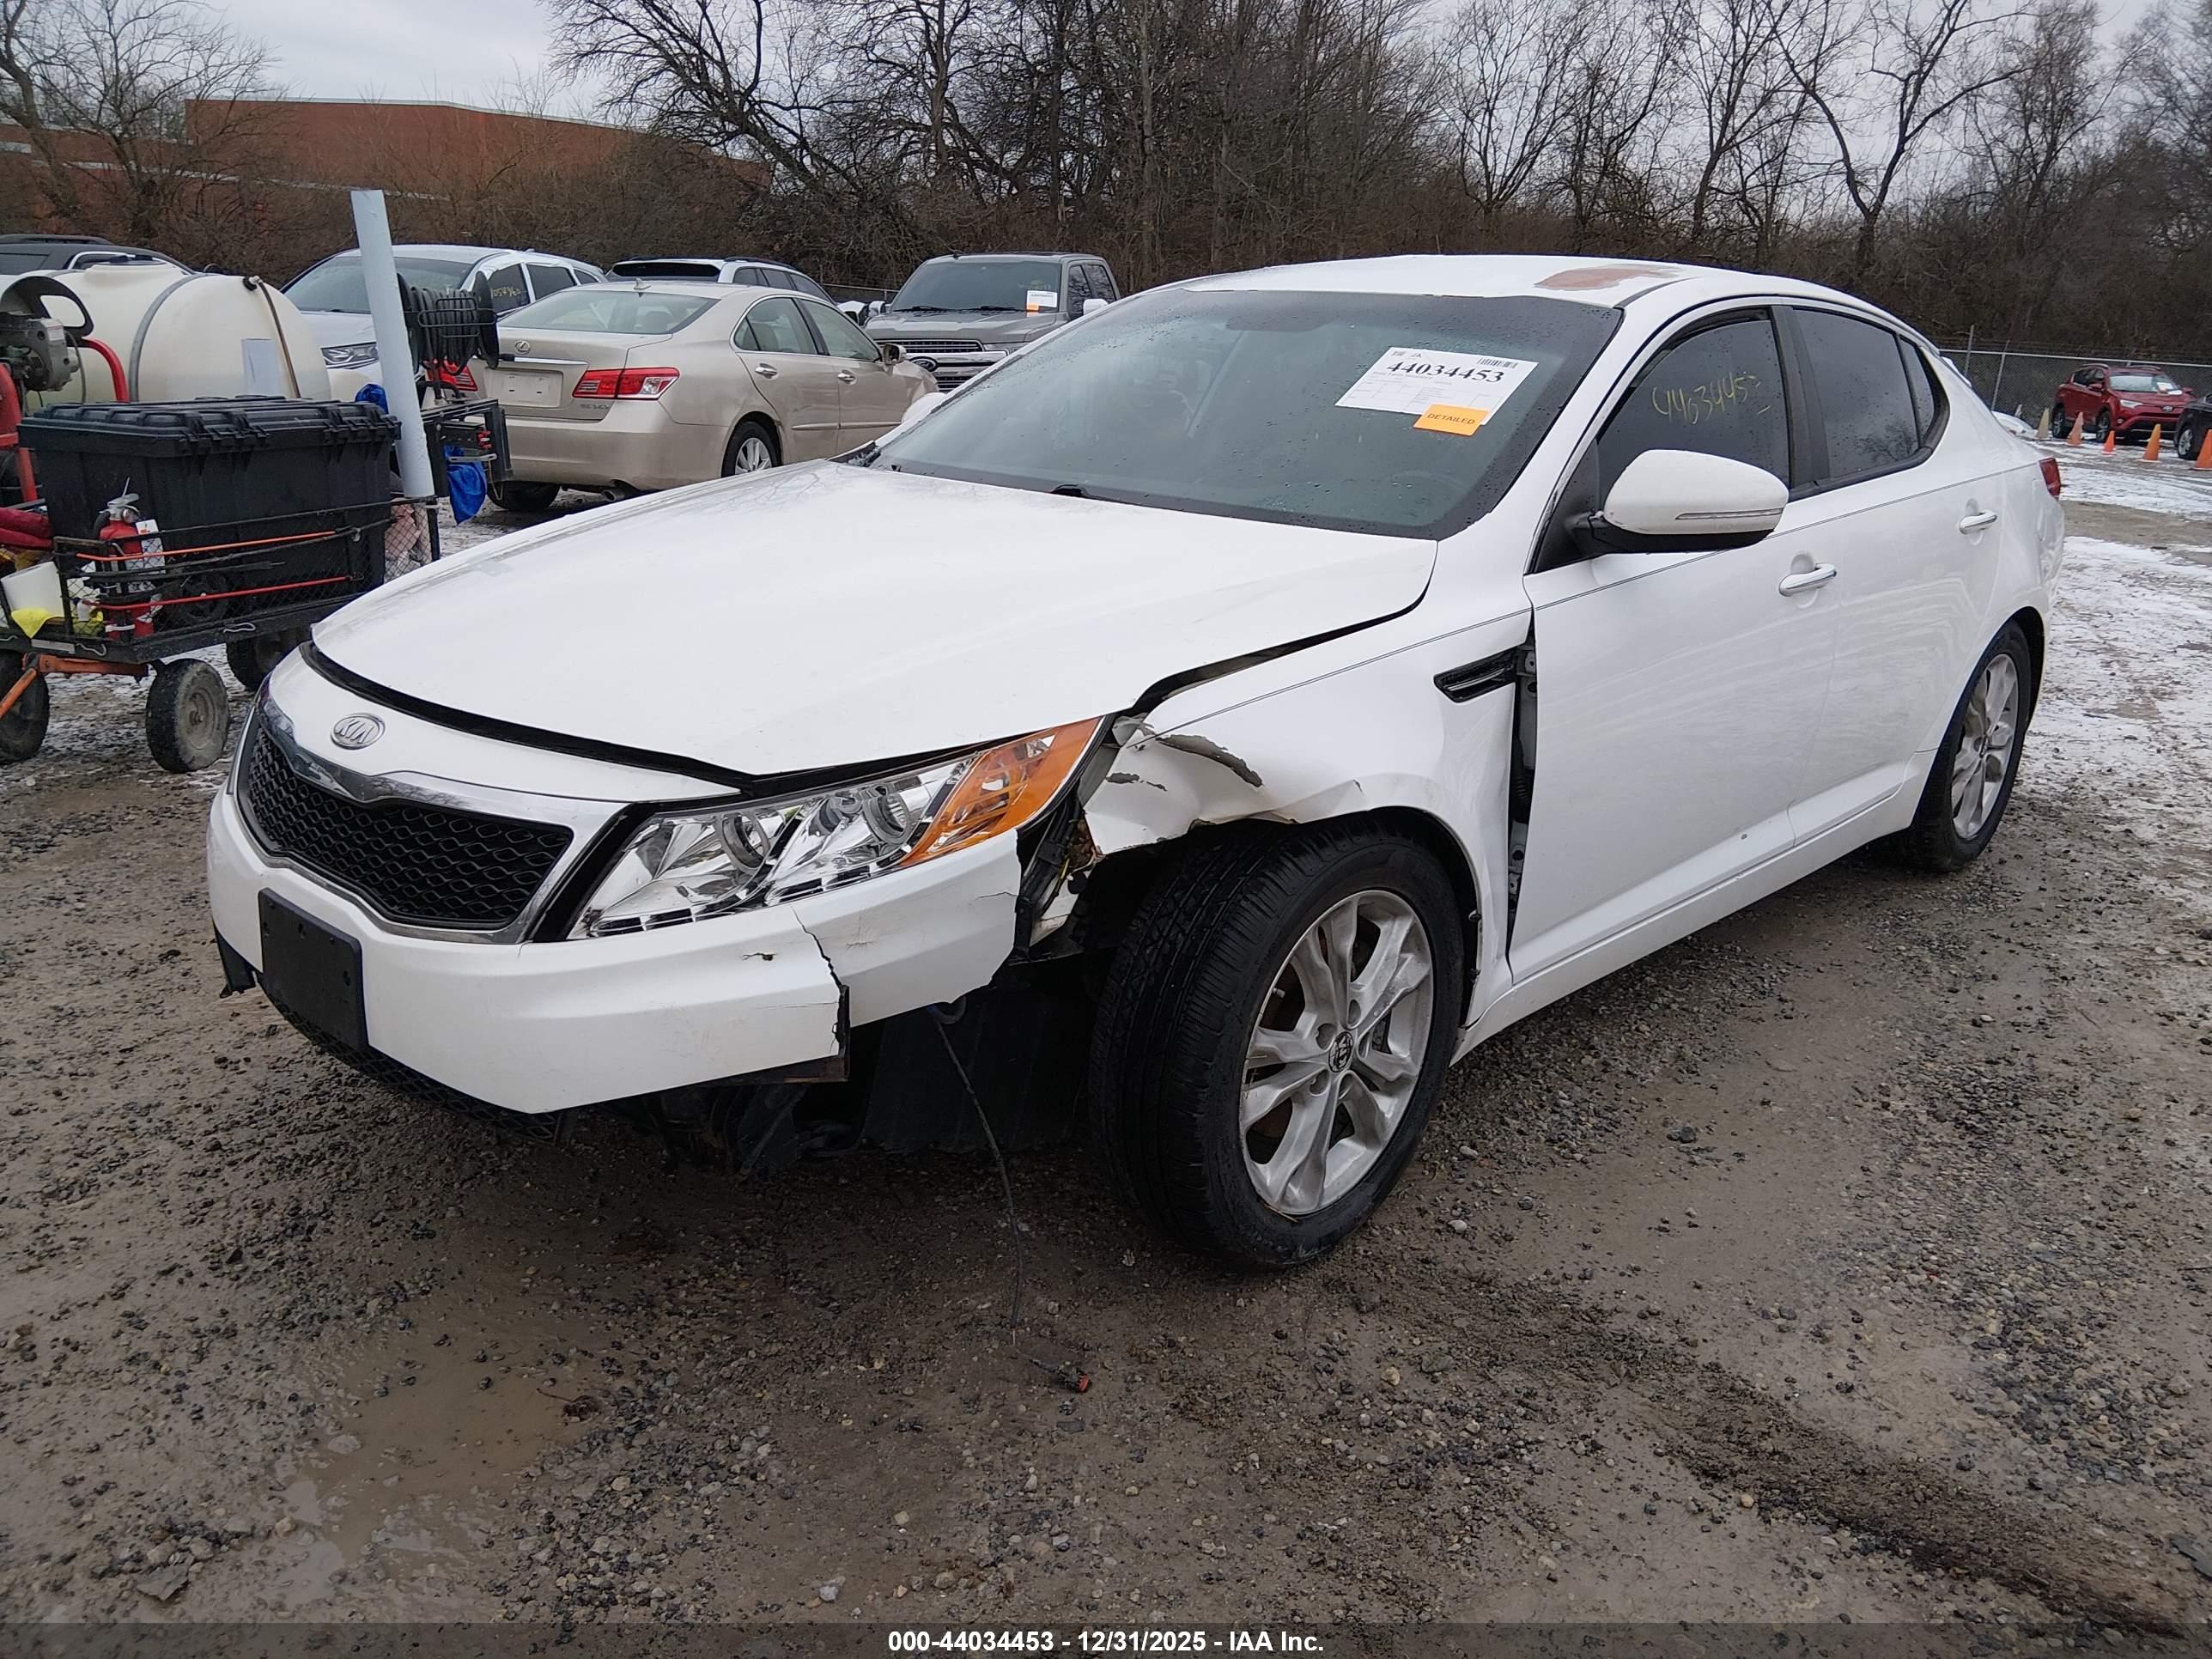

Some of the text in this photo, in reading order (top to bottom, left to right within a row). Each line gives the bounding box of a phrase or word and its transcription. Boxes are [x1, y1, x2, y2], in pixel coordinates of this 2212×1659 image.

[1388, 362, 1504, 383] 44034453
[1427, 413, 1476, 424] DETAILED
[334, 718, 375, 744] KIA
